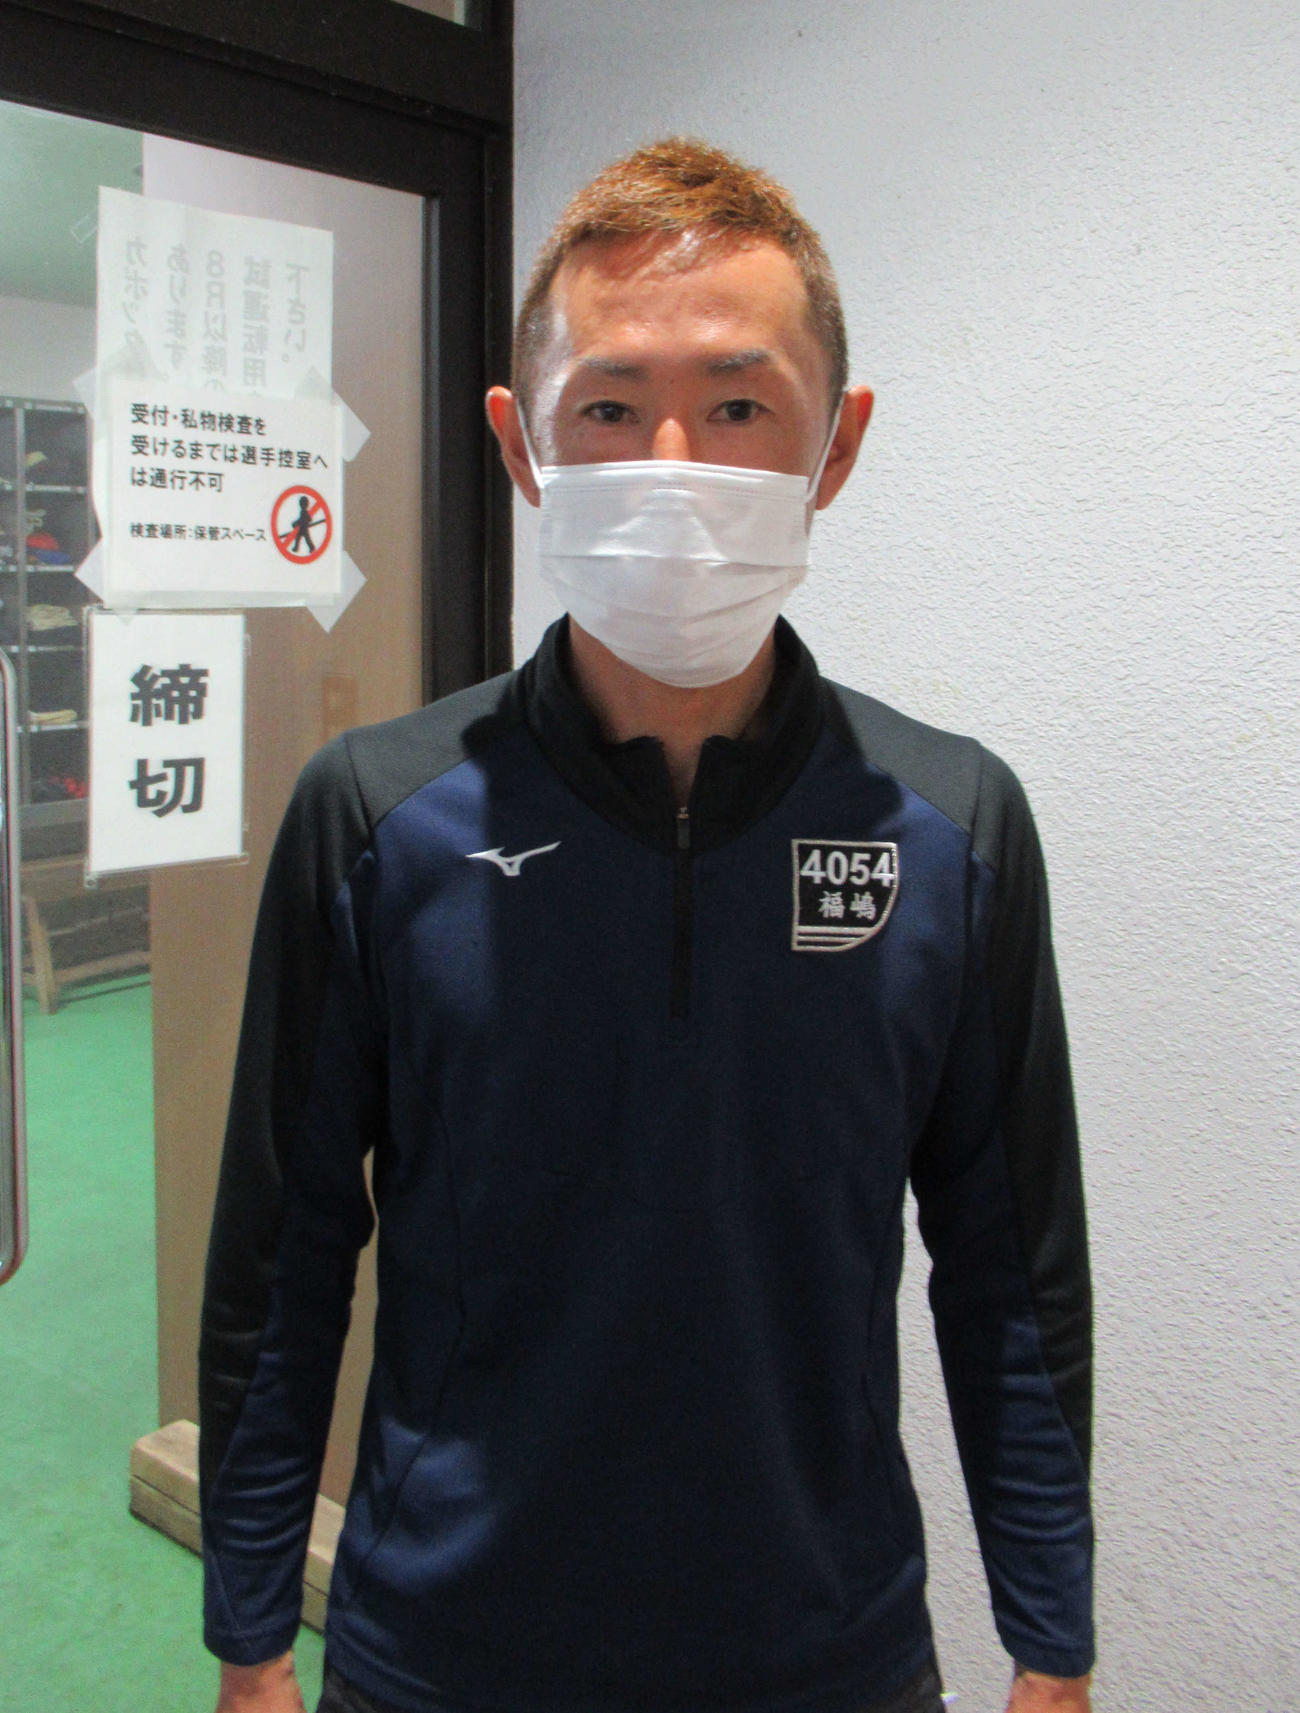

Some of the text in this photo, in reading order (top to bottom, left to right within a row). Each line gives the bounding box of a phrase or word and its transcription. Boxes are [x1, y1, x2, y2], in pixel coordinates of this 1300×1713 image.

[131, 403, 267, 436] 受付・私物検査を
[131, 434, 328, 470] 受けるまでは選手控室へ
[131, 466, 224, 493] は通行不可
[128, 664, 210, 818] 締切
[800, 848, 896, 888] 4054
